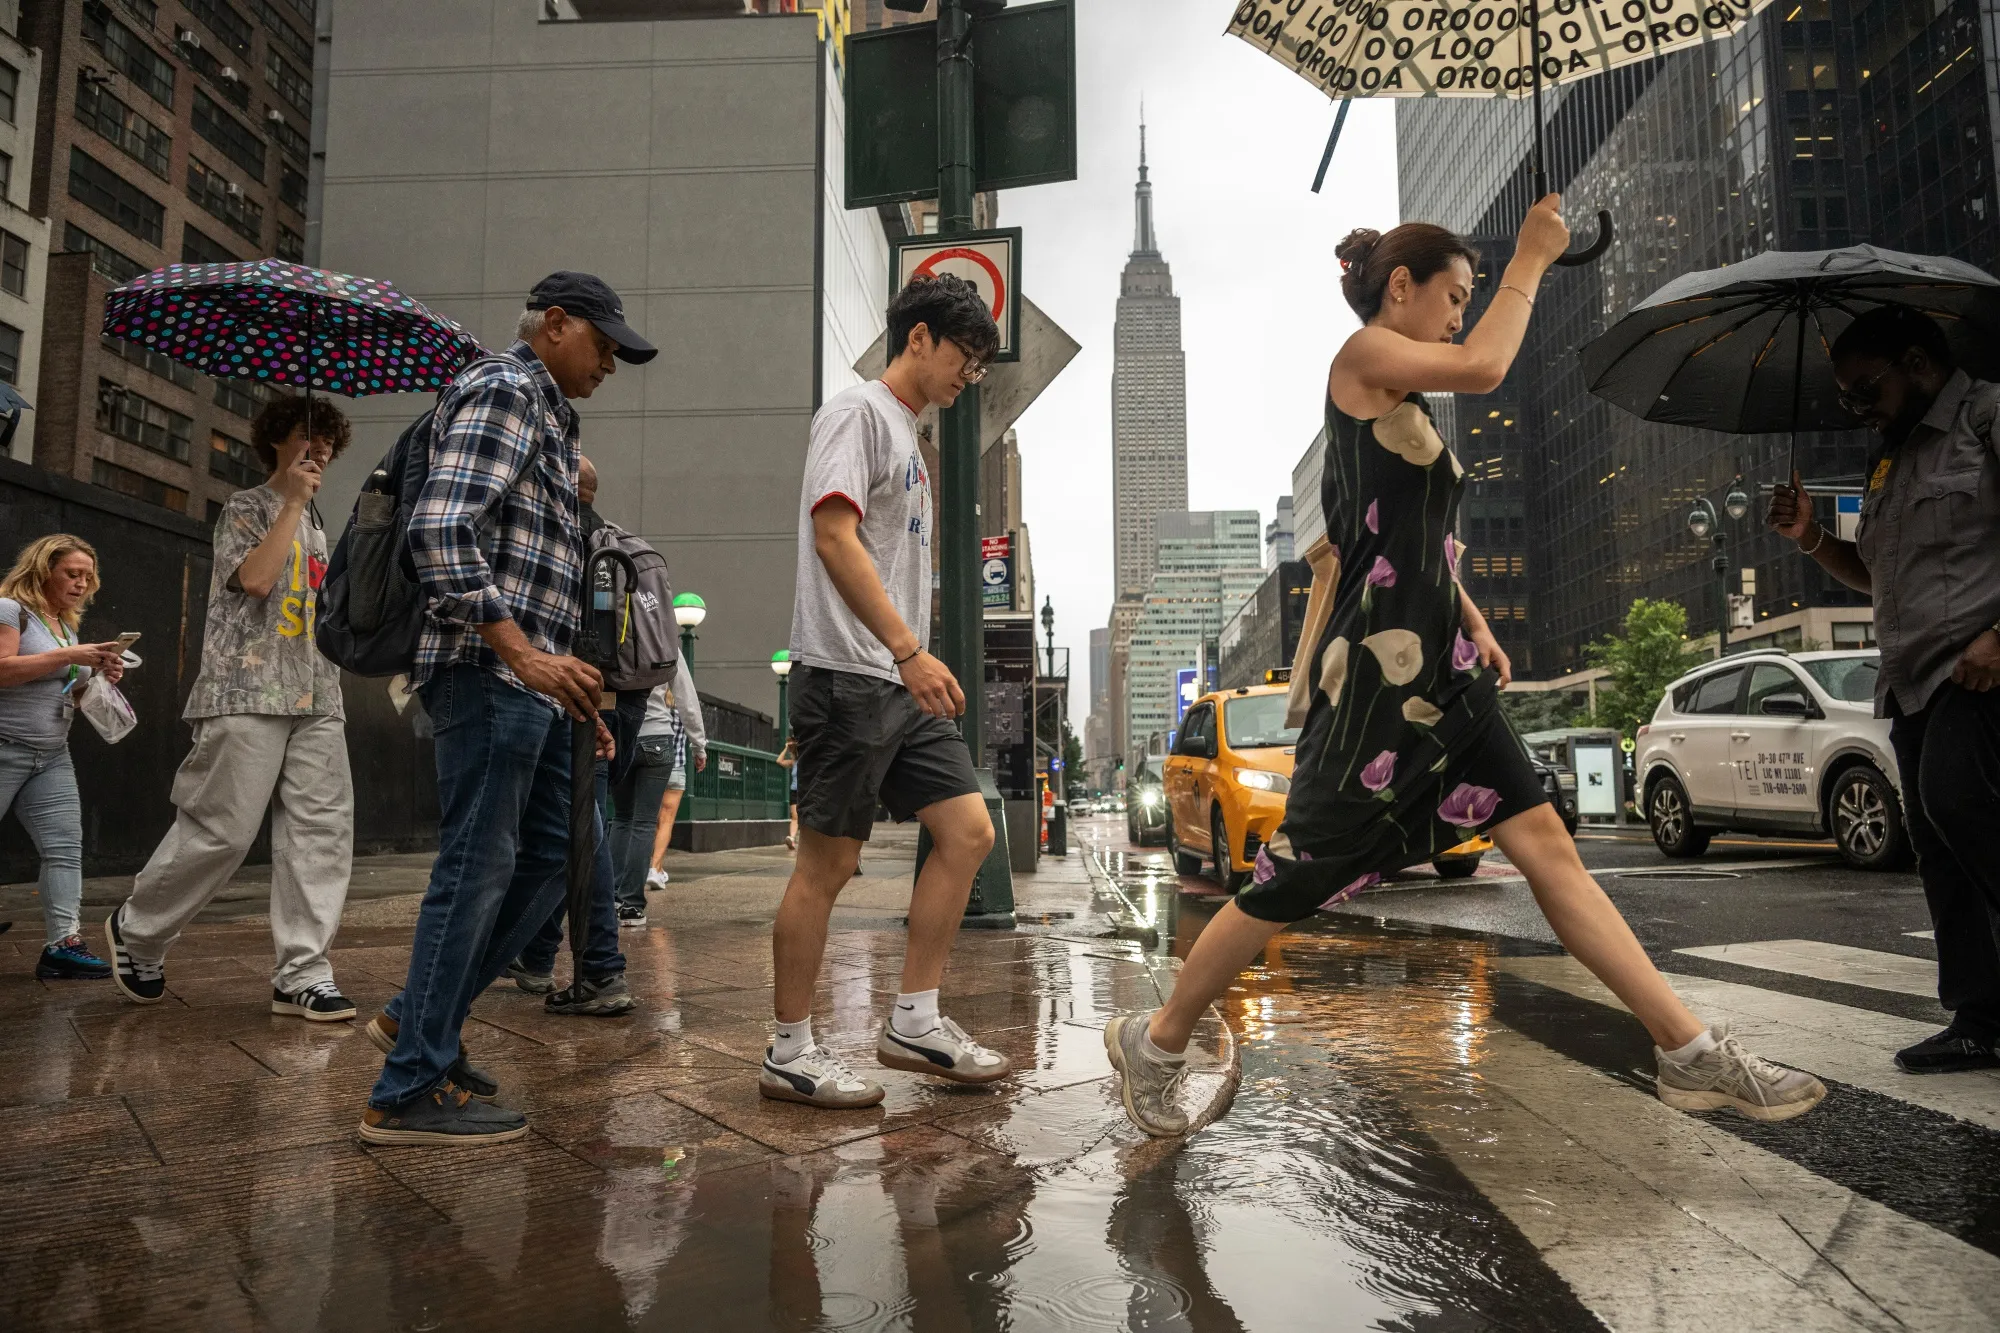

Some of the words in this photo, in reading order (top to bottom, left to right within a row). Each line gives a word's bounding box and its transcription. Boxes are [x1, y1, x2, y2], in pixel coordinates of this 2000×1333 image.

[1431, 37, 1494, 60] LOO
[989, 538, 999, 546] NO
[982, 543, 1008, 552] STANDING
[1793, 752, 1804, 764] AVE
